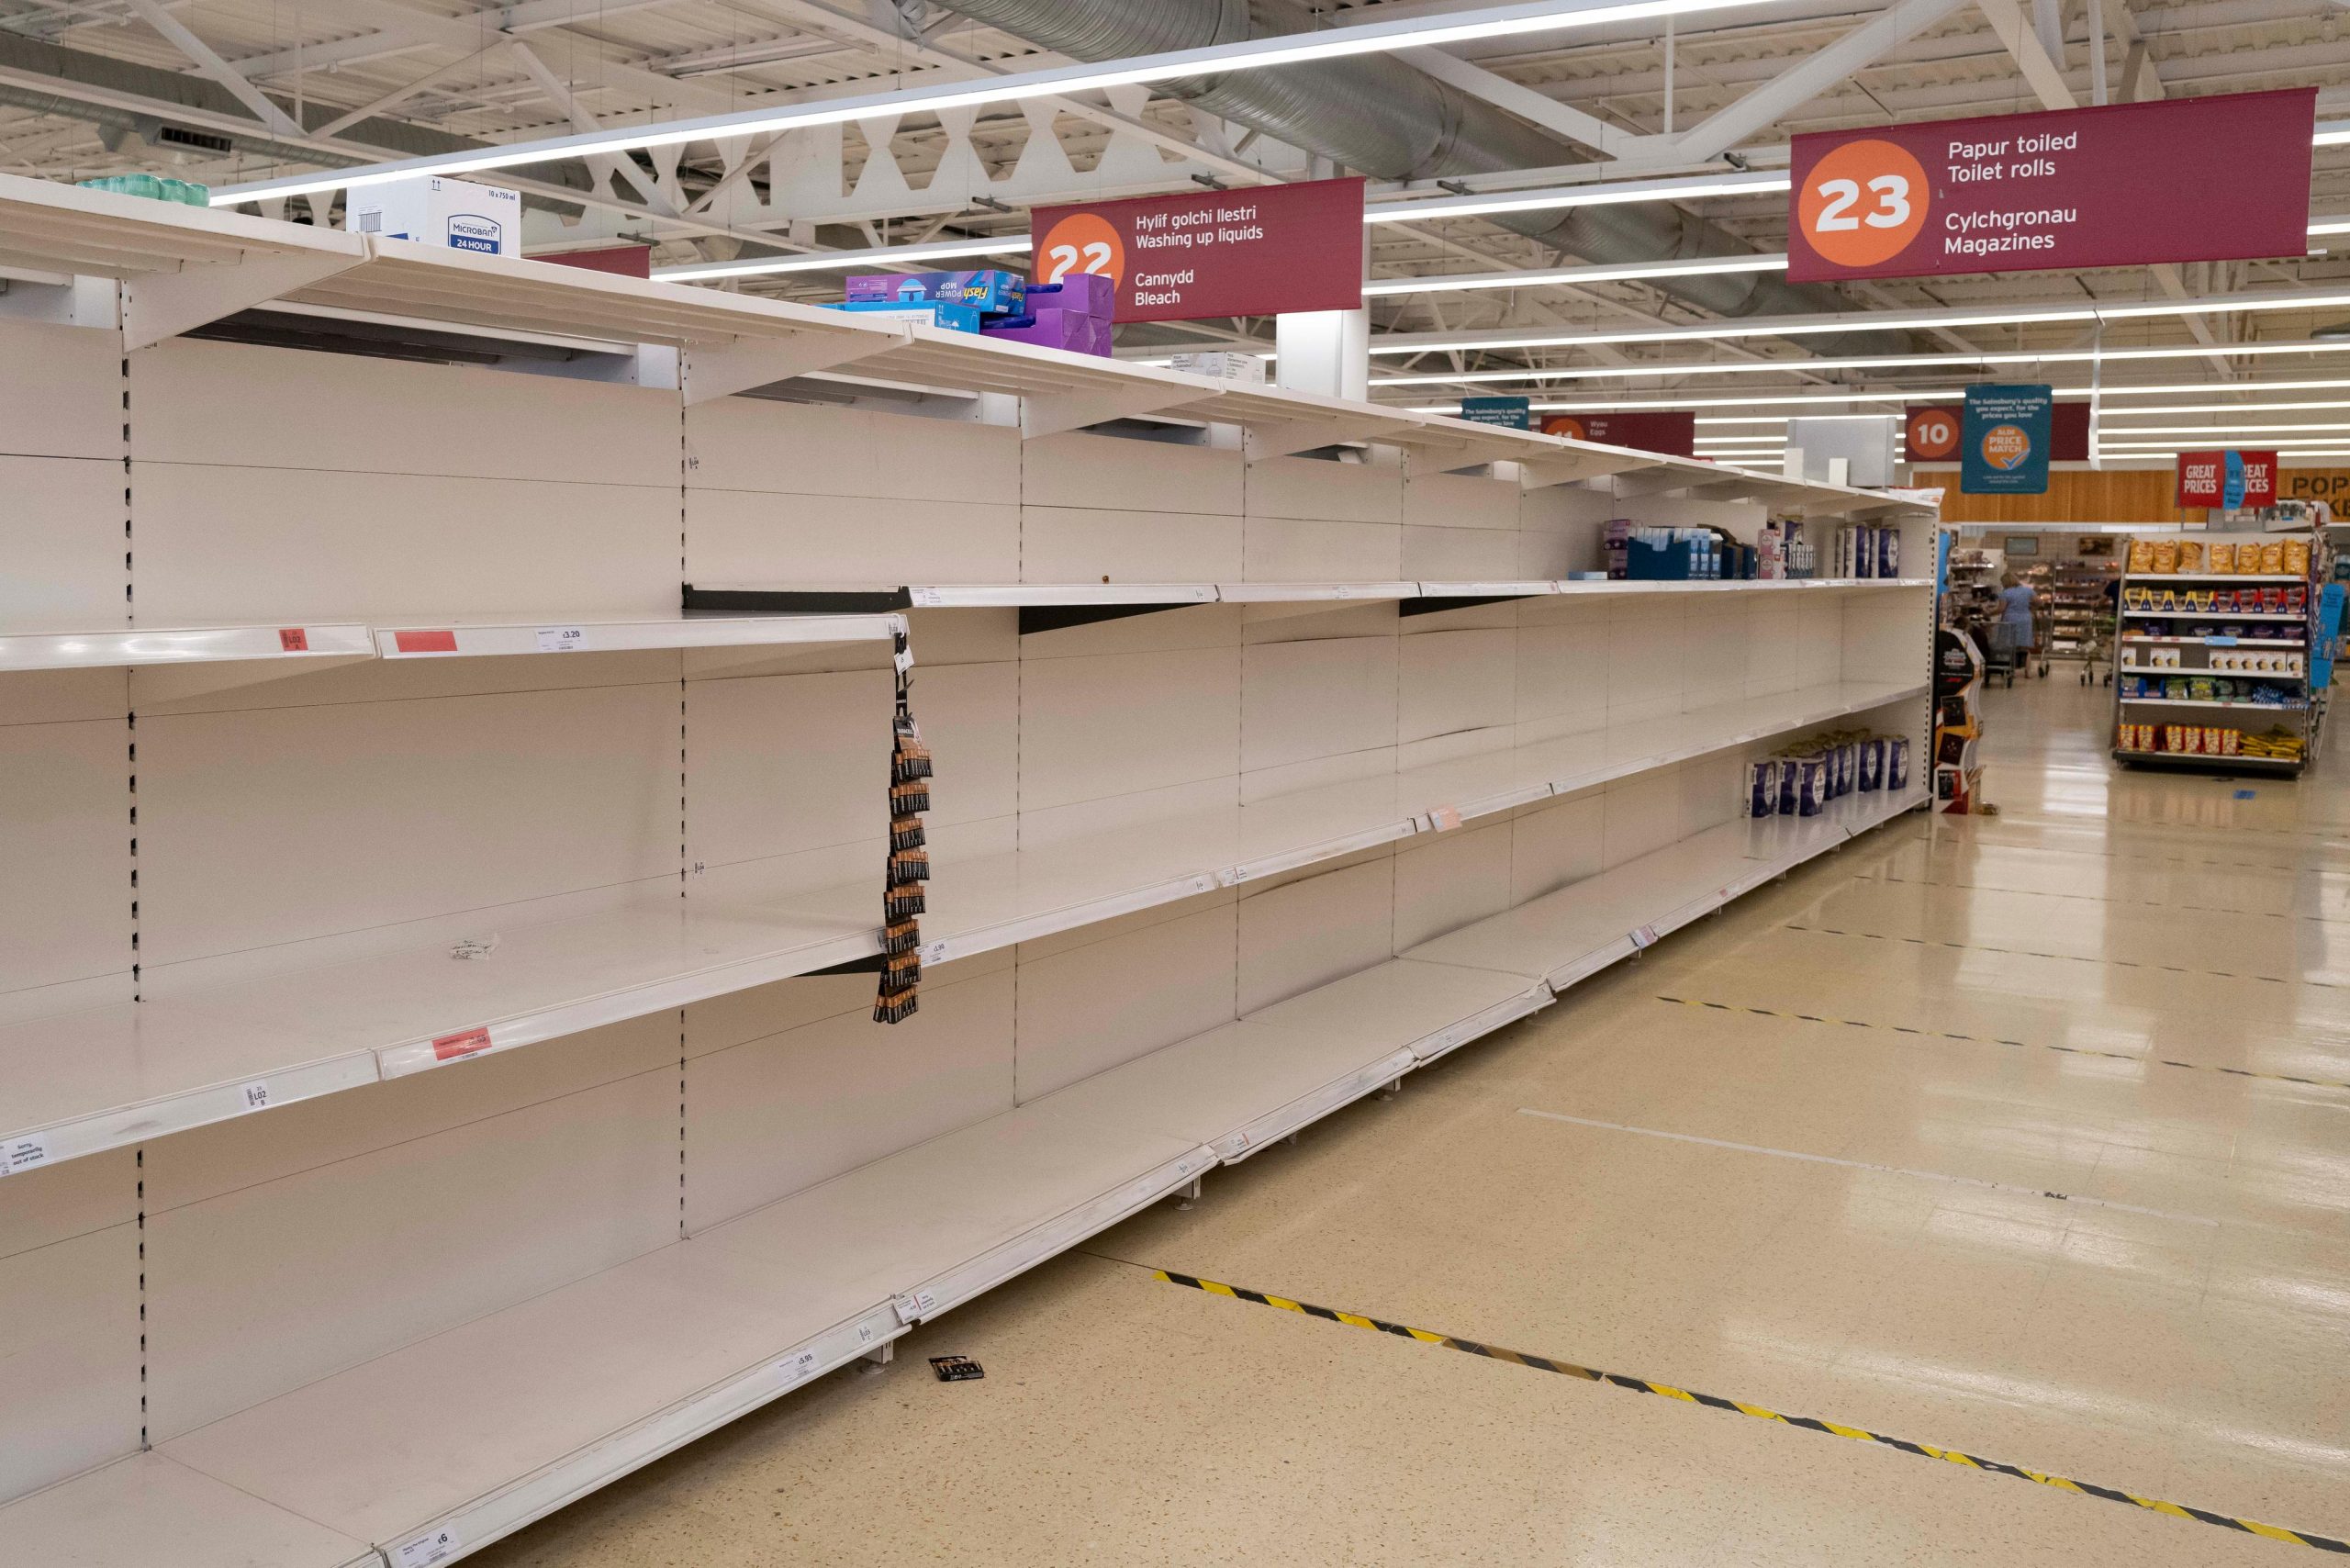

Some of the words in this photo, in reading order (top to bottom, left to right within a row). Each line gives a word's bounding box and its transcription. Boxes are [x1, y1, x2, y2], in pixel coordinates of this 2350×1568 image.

[1948, 140, 2010, 162] Papur
[2016, 130, 2078, 154] toiled
[1947, 162, 2004, 184] Toilet
[2010, 158, 2056, 179] rolls
[488, 189, 495, 197] 10
[499, 191, 509, 200] 750
[509, 193, 516, 201] ml
[1816, 174, 1911, 233] 23
[1136, 212, 1168, 232] Hylif
[1171, 208, 1213, 230] golchi
[1216, 204, 1257, 223] llestri
[1944, 207, 2077, 234] Cylchgronau
[453, 223, 493, 237] MICROBAN
[1136, 231, 1192, 249] Washing
[1196, 230, 1214, 247] up
[1218, 224, 1264, 244] liquids
[456, 239, 467, 248] 24
[468, 241, 492, 252] HOUR
[1944, 231, 2055, 257] Magazines
[1048, 241, 1112, 285] 22
[1135, 268, 1194, 288] Cannydd
[940, 282, 957, 290] MOP
[963, 286, 989, 300] Flash
[935, 289, 962, 298] POWER
[1135, 289, 1181, 307] Bleach
[1983, 398, 2021, 406] Sainsbury's
[1982, 411, 2003, 420] prices
[1589, 429, 1606, 437] Eggs
[1918, 423, 1949, 445] 10
[1988, 436, 2022, 444] PRICE
[2186, 465, 2217, 479] GREAT
[2184, 479, 2217, 494] PRICES
[253, 1090, 266, 1101] L02
[11, 1147, 42, 1159] temporarily
[29, 1153, 44, 1161] stock
[437, 1533, 448, 1545] £6
